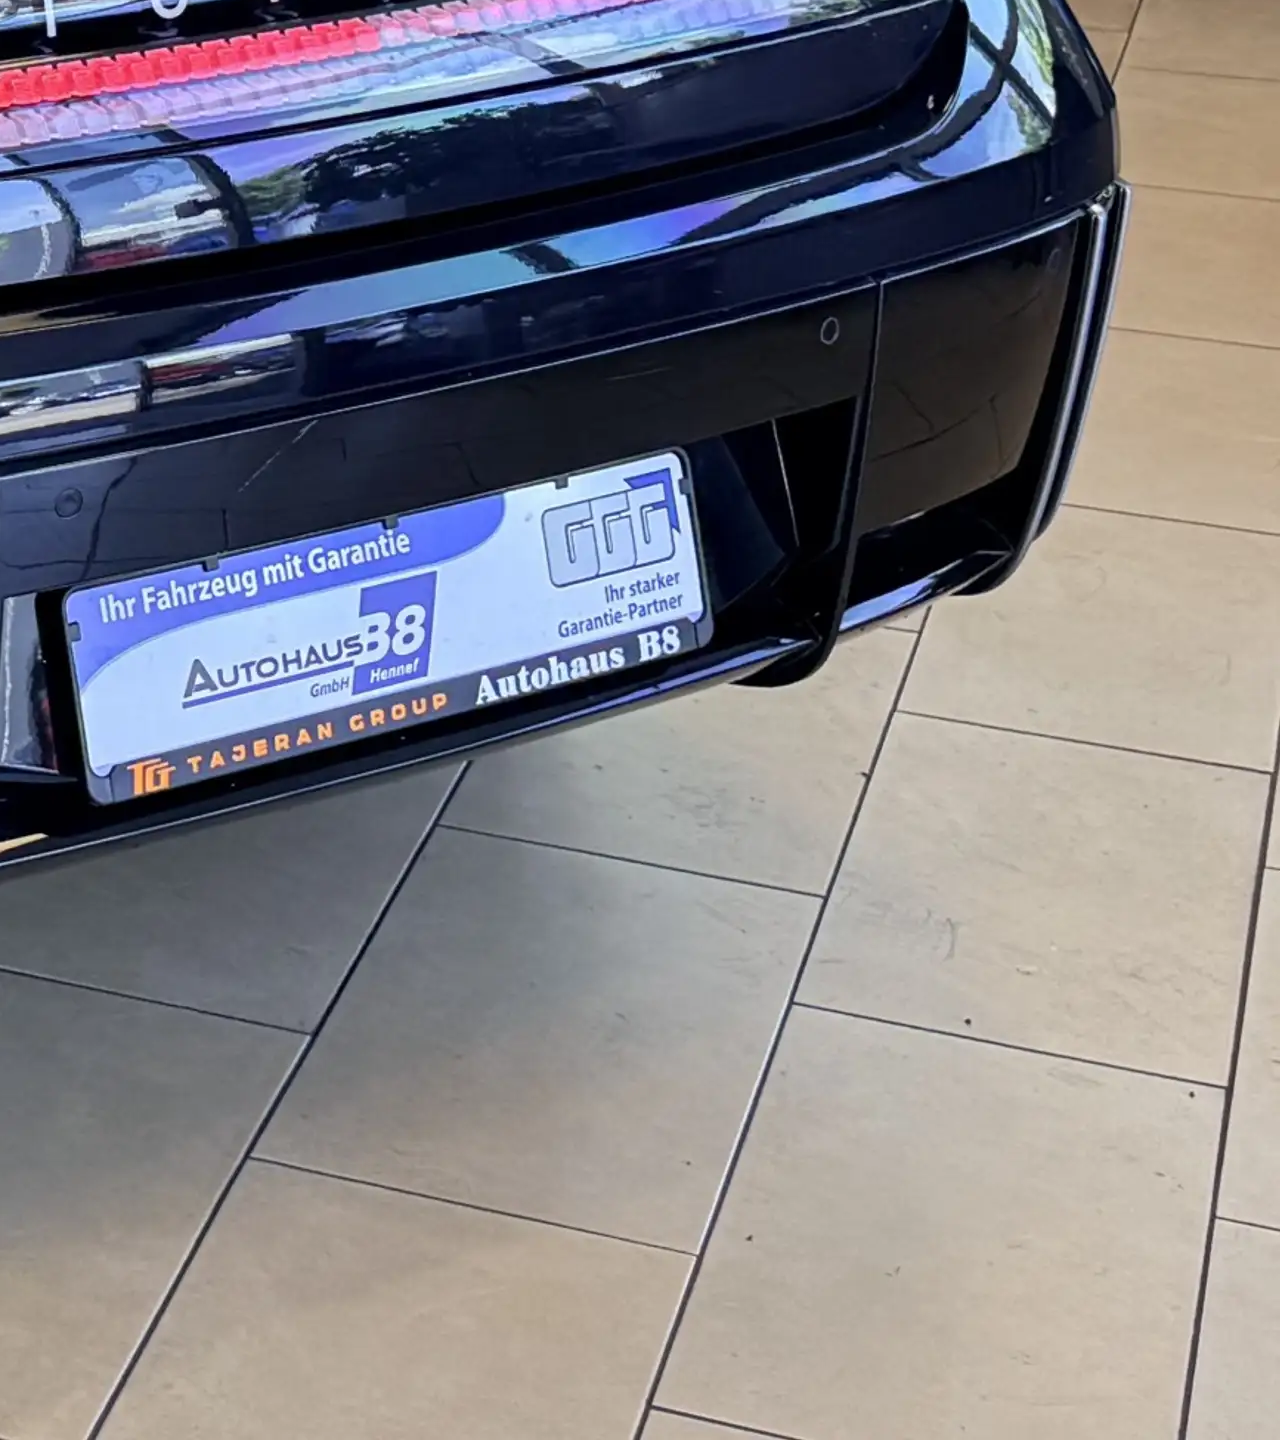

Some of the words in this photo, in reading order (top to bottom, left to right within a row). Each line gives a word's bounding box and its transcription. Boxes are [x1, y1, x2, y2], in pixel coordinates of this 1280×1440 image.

[99, 593, 136, 624] Ihr
[142, 569, 257, 614] Fahrzeug
[263, 553, 304, 587] mit
[308, 530, 411, 574] Garantie
[604, 584, 626, 603] Ihr
[629, 570, 681, 597] starker
[557, 593, 684, 638] Garantie-Partner
[187, 721, 334, 775] TAJERAN
[348, 692, 449, 733] GROUP
[474, 643, 626, 706] Autohaus
[636, 625, 682, 663] B8
[310, 676, 350, 698] GmbH
[369, 658, 420, 684] Hennef
